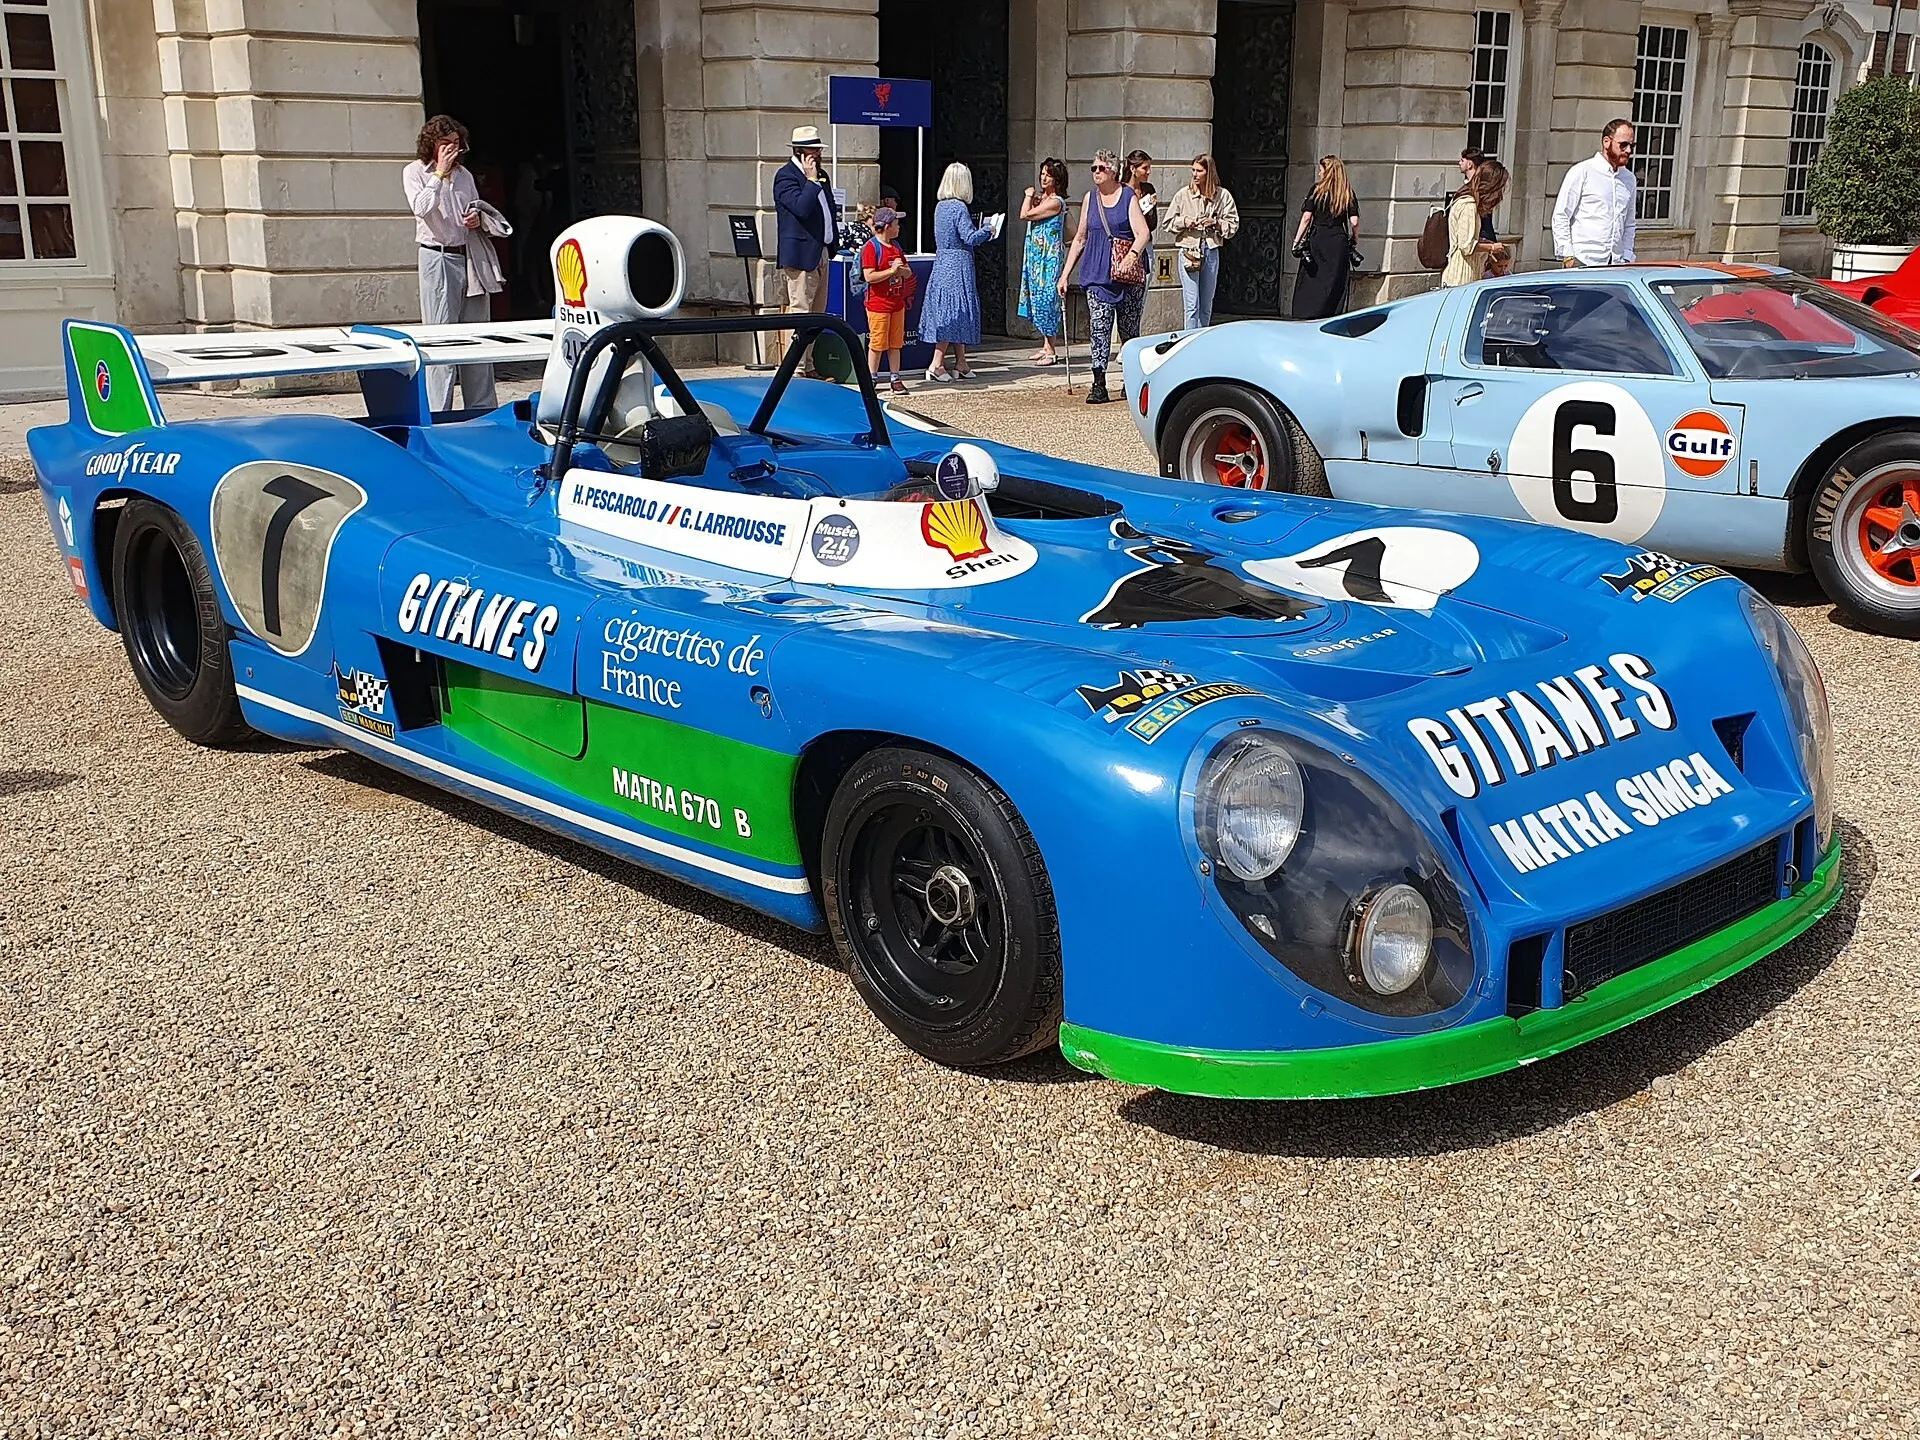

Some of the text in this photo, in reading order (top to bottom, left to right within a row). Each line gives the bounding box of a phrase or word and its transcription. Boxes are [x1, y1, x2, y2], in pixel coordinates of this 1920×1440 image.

[560, 307, 600, 325] Shell
[1553, 400, 1618, 524] 6
[1668, 432, 1733, 456] Gulf
[815, 522, 858, 538] Musée
[1812, 465, 1856, 543] AVON
[262, 474, 336, 637] 7
[945, 554, 1019, 579] Shell
[1295, 536, 1395, 604] 7
[398, 573, 560, 673] GITANES
[604, 609, 764, 676] cigarettes de
[601, 650, 683, 709] France
[1407, 653, 1678, 799] GITANES
[612, 766, 752, 838] MATRA 670 B
[1489, 752, 1735, 874] MATRA SIMCA
